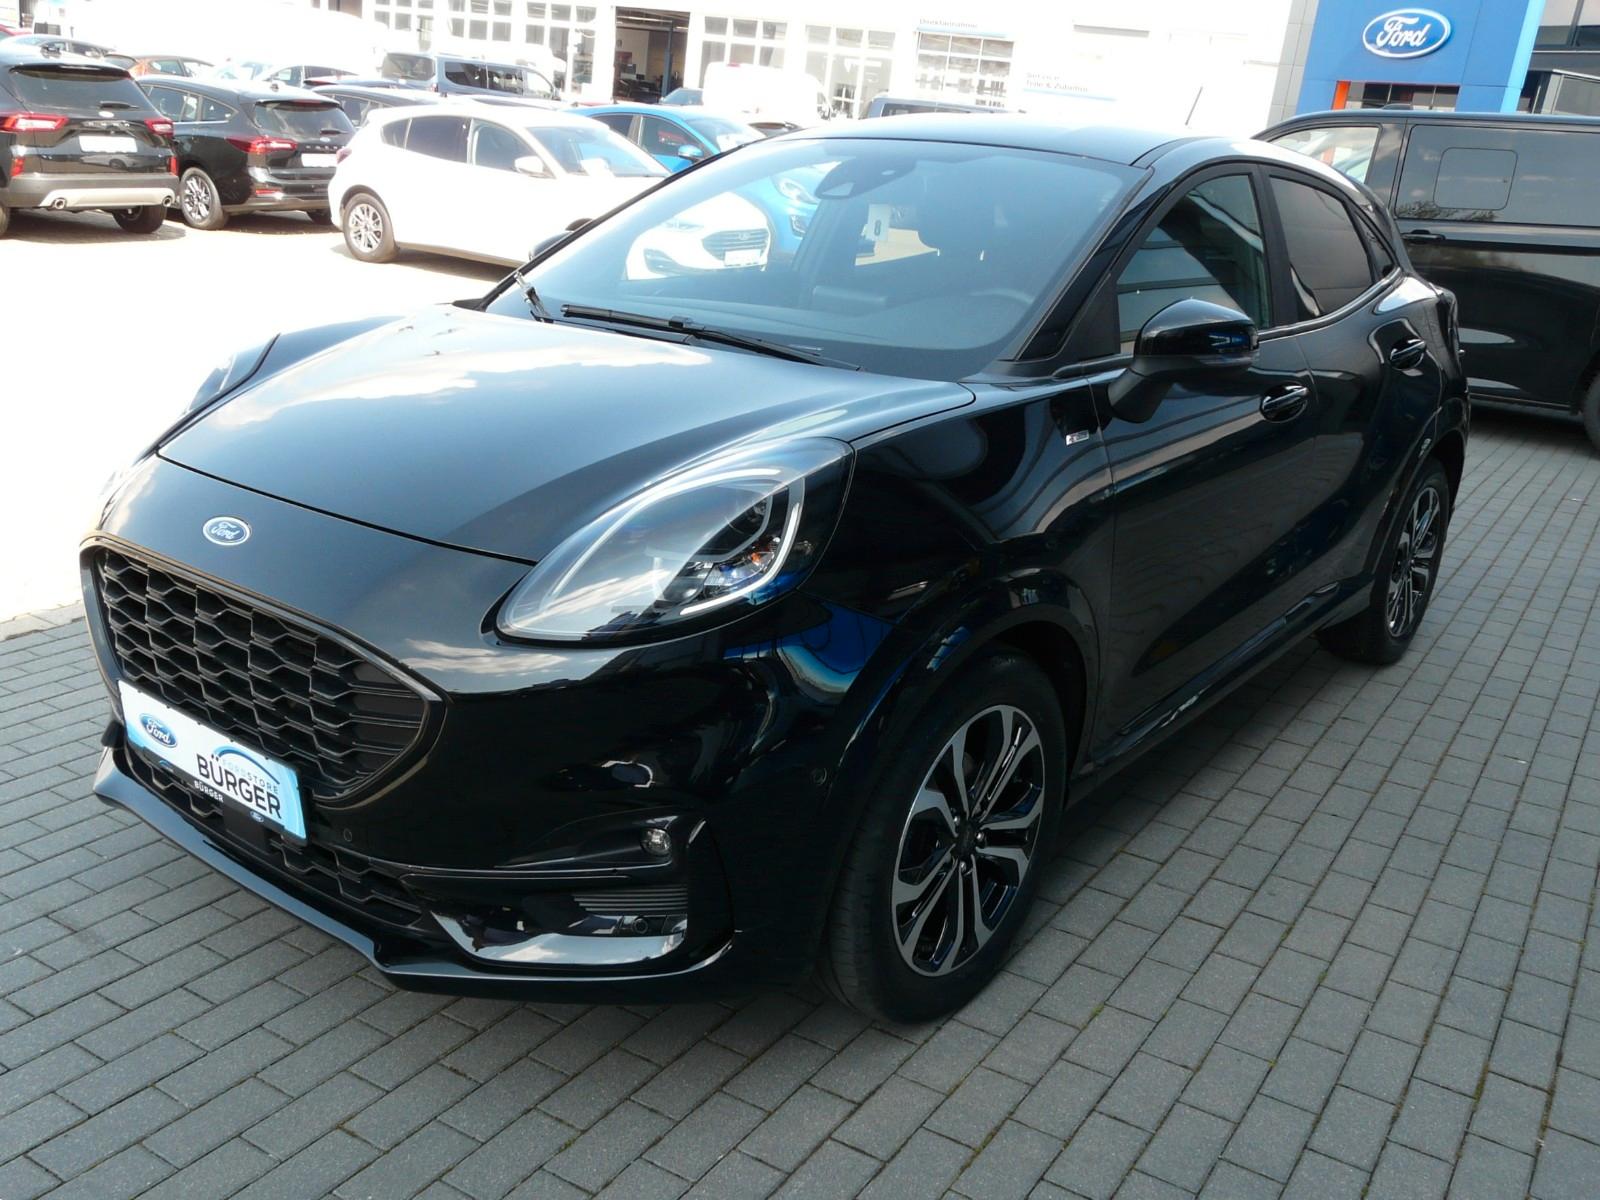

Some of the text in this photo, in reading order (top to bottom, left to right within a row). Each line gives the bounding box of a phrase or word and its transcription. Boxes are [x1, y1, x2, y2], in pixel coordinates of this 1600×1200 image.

[1376, 16, 1431, 47] Ford
[211, 521, 240, 540] Ford
[145, 718, 171, 744] Ford
[194, 780, 224, 802] BÜRGER
[197, 754, 282, 819] BÜRGER
